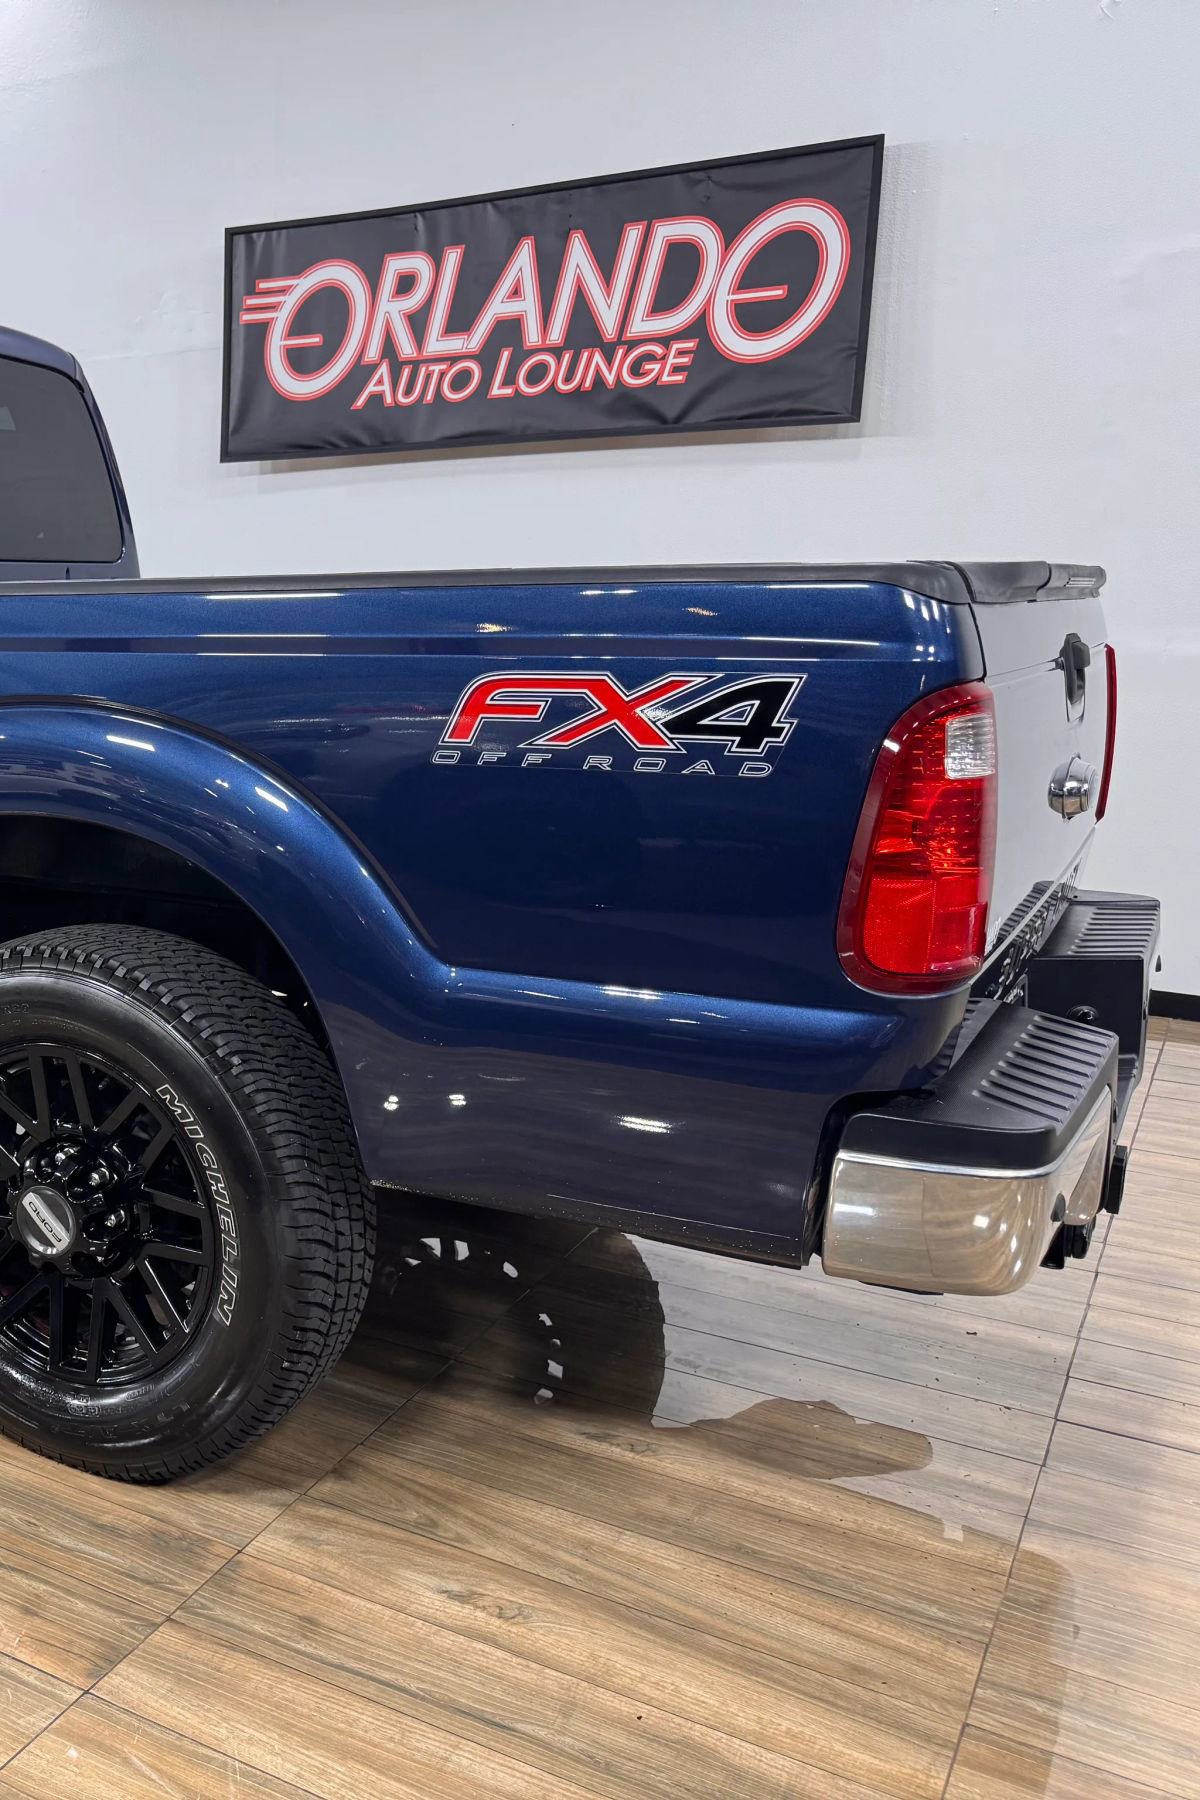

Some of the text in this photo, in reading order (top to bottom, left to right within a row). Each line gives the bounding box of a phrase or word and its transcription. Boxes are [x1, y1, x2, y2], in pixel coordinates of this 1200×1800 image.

[264, 197, 851, 401] ORLANDO
[351, 339, 698, 410] AUTO LOUNGE
[438, 671, 808, 757] FX4
[431, 750, 773, 777] OFF ROAD
[28, 1201, 62, 1242] FORD
[157, 1084, 242, 1327] MICHELIN
